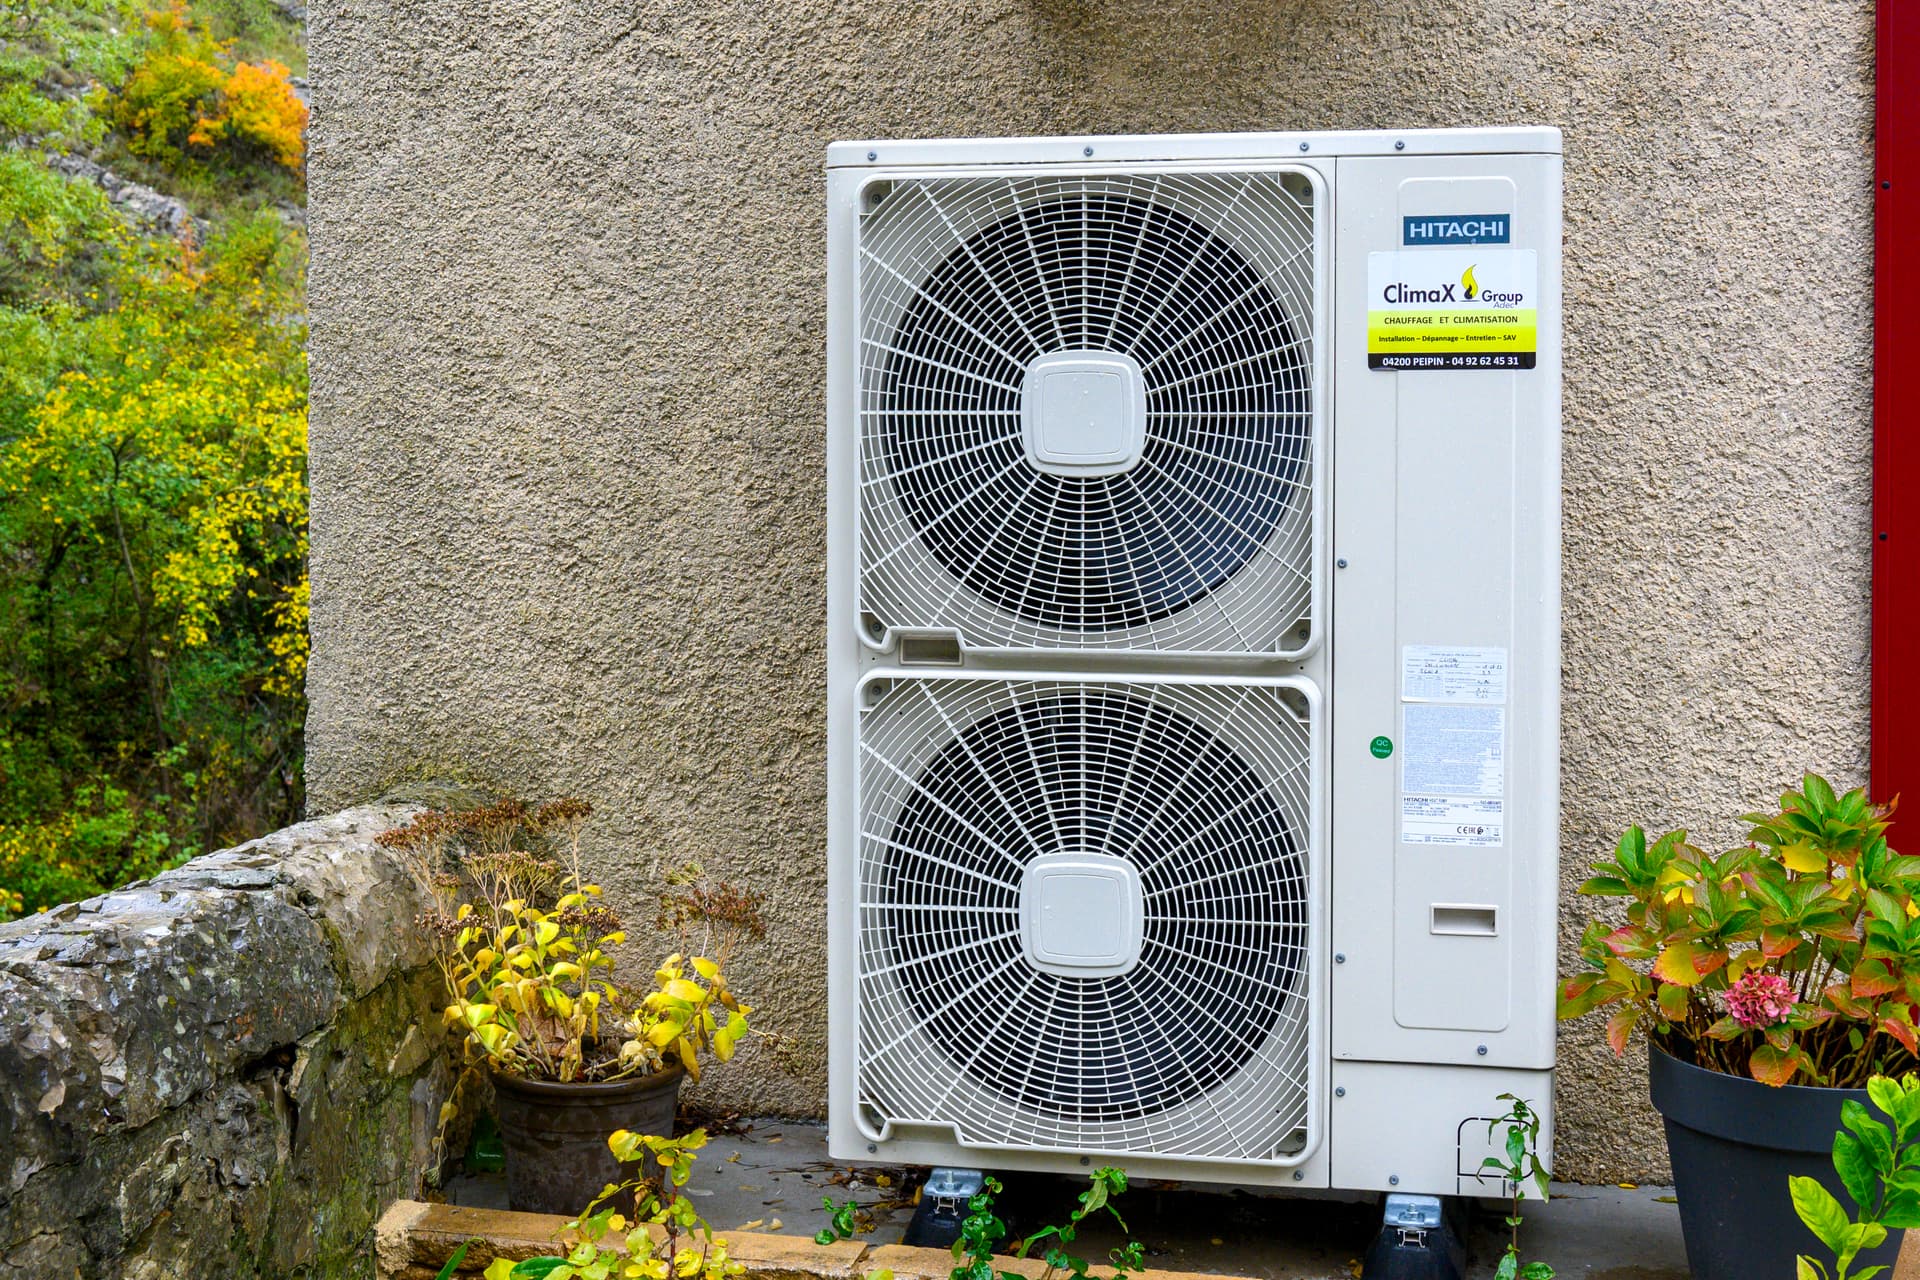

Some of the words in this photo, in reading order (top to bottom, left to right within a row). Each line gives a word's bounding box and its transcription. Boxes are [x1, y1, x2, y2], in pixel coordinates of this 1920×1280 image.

[1409, 221, 1504, 238] HITACHI
[1383, 282, 1456, 303] ClimaX
[1481, 289, 1523, 305] Group
[1384, 316, 1433, 325] CHAUFFAGE
[1439, 316, 1449, 324] ET
[1453, 315, 1518, 324] CLIMATISATION
[1422, 335, 1459, 343] Dépannage
[1382, 357, 1411, 366] 04200
[1413, 356, 1444, 366] PEIPIN
[1451, 356, 1464, 366] 04
[1465, 356, 1478, 366] 92
[1479, 356, 1492, 366] 62
[1493, 356, 1505, 366] 45
[1507, 356, 1519, 366] 31
